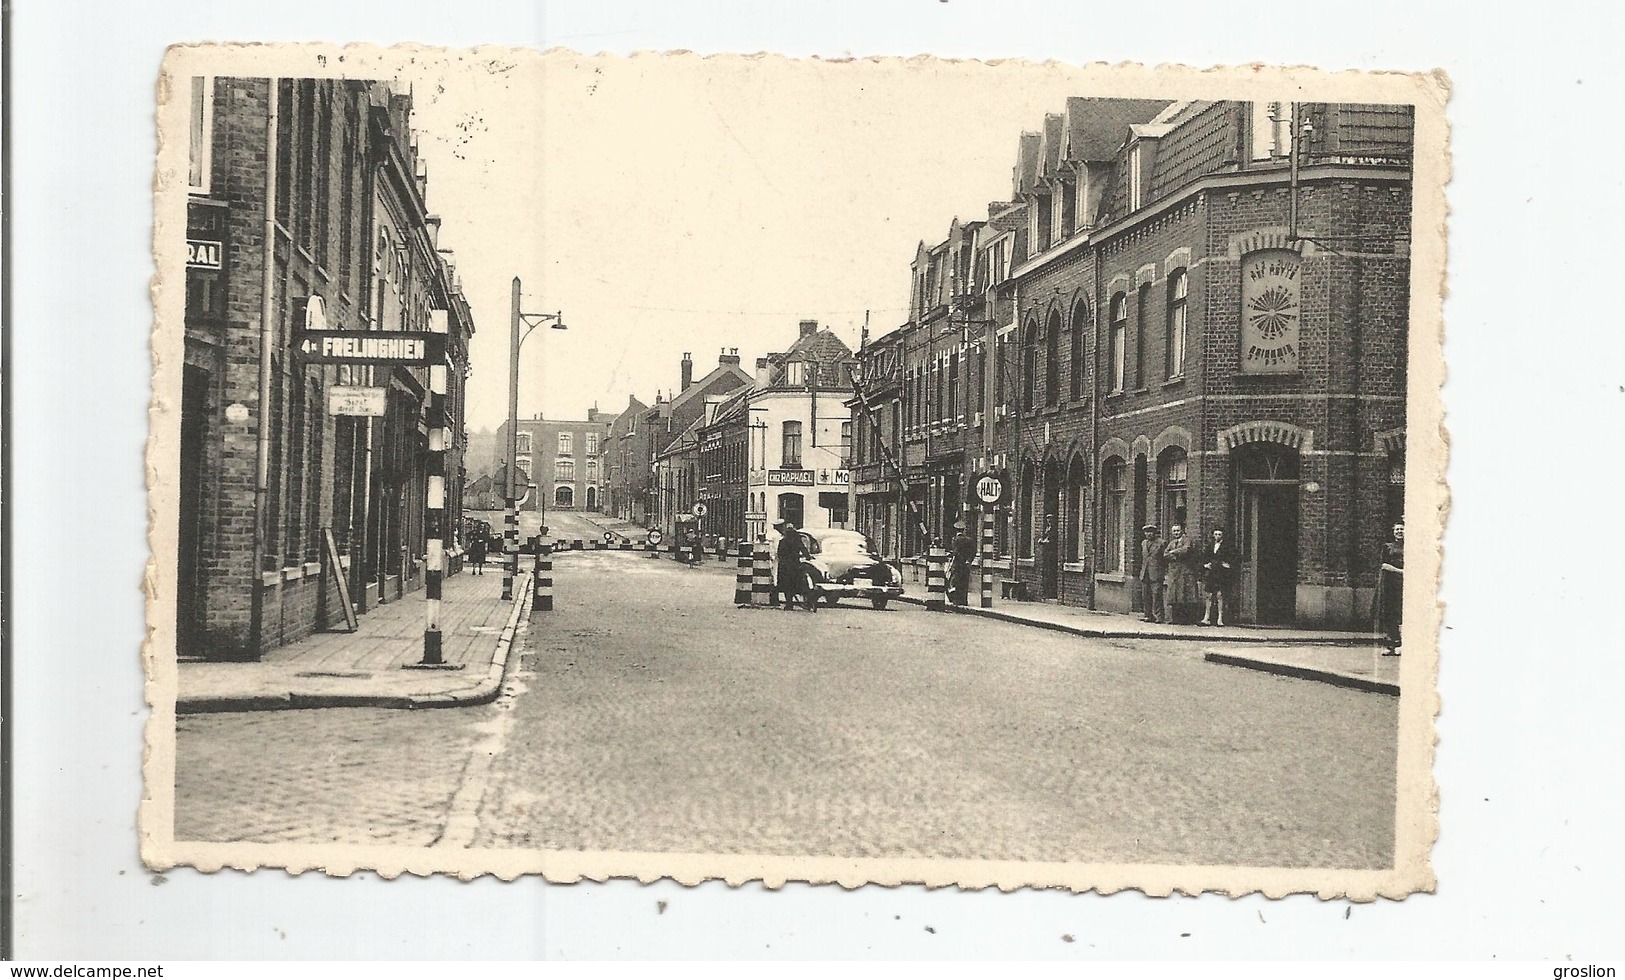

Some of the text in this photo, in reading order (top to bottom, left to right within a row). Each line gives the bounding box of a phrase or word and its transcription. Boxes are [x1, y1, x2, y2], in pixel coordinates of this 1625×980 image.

[186, 244, 219, 265] RAL
[323, 337, 425, 360] FRELINGHIEN
[781, 472, 813, 482] RAPHAEL
[980, 482, 998, 497] HALT
